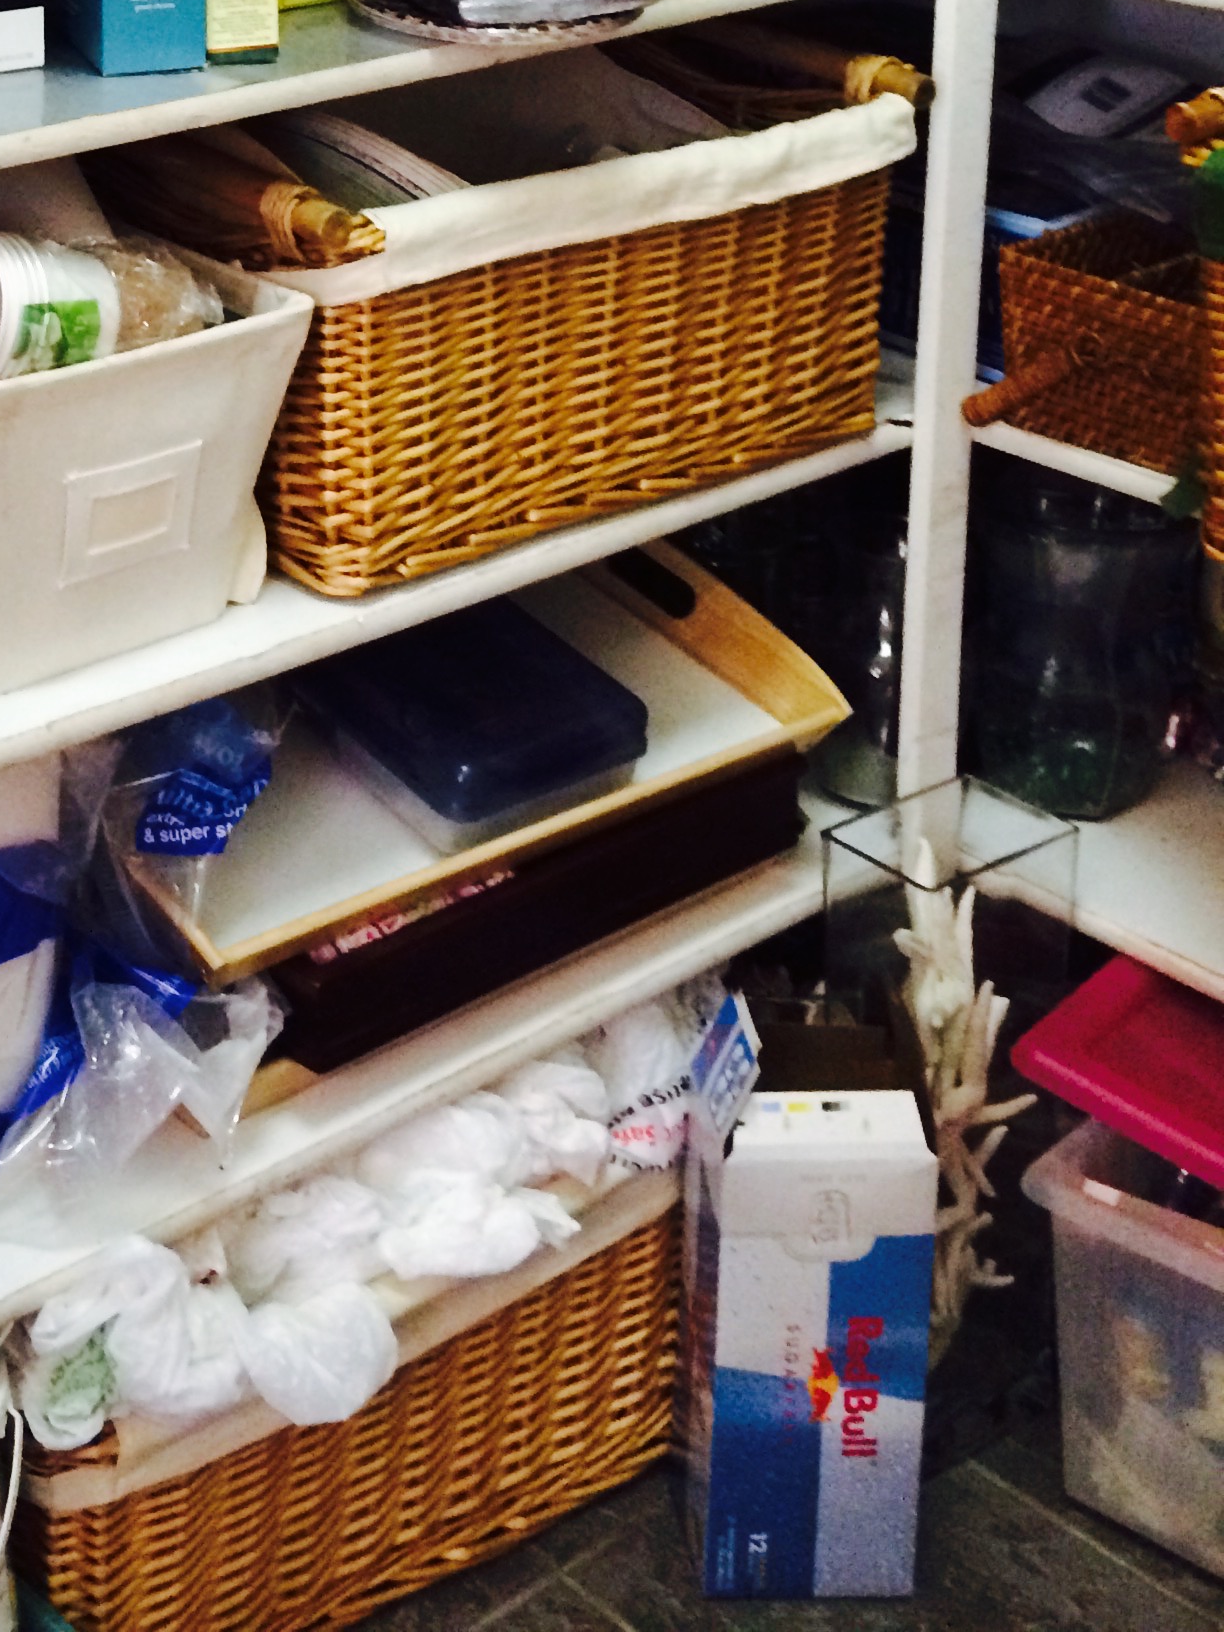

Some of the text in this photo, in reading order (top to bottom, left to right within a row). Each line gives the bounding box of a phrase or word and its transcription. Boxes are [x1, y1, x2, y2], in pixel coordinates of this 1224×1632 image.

[143, 827, 155, 843] &
[160, 824, 210, 845] super
[841, 1316, 884, 1458] Red Bull
[748, 1532, 769, 1554] 12
